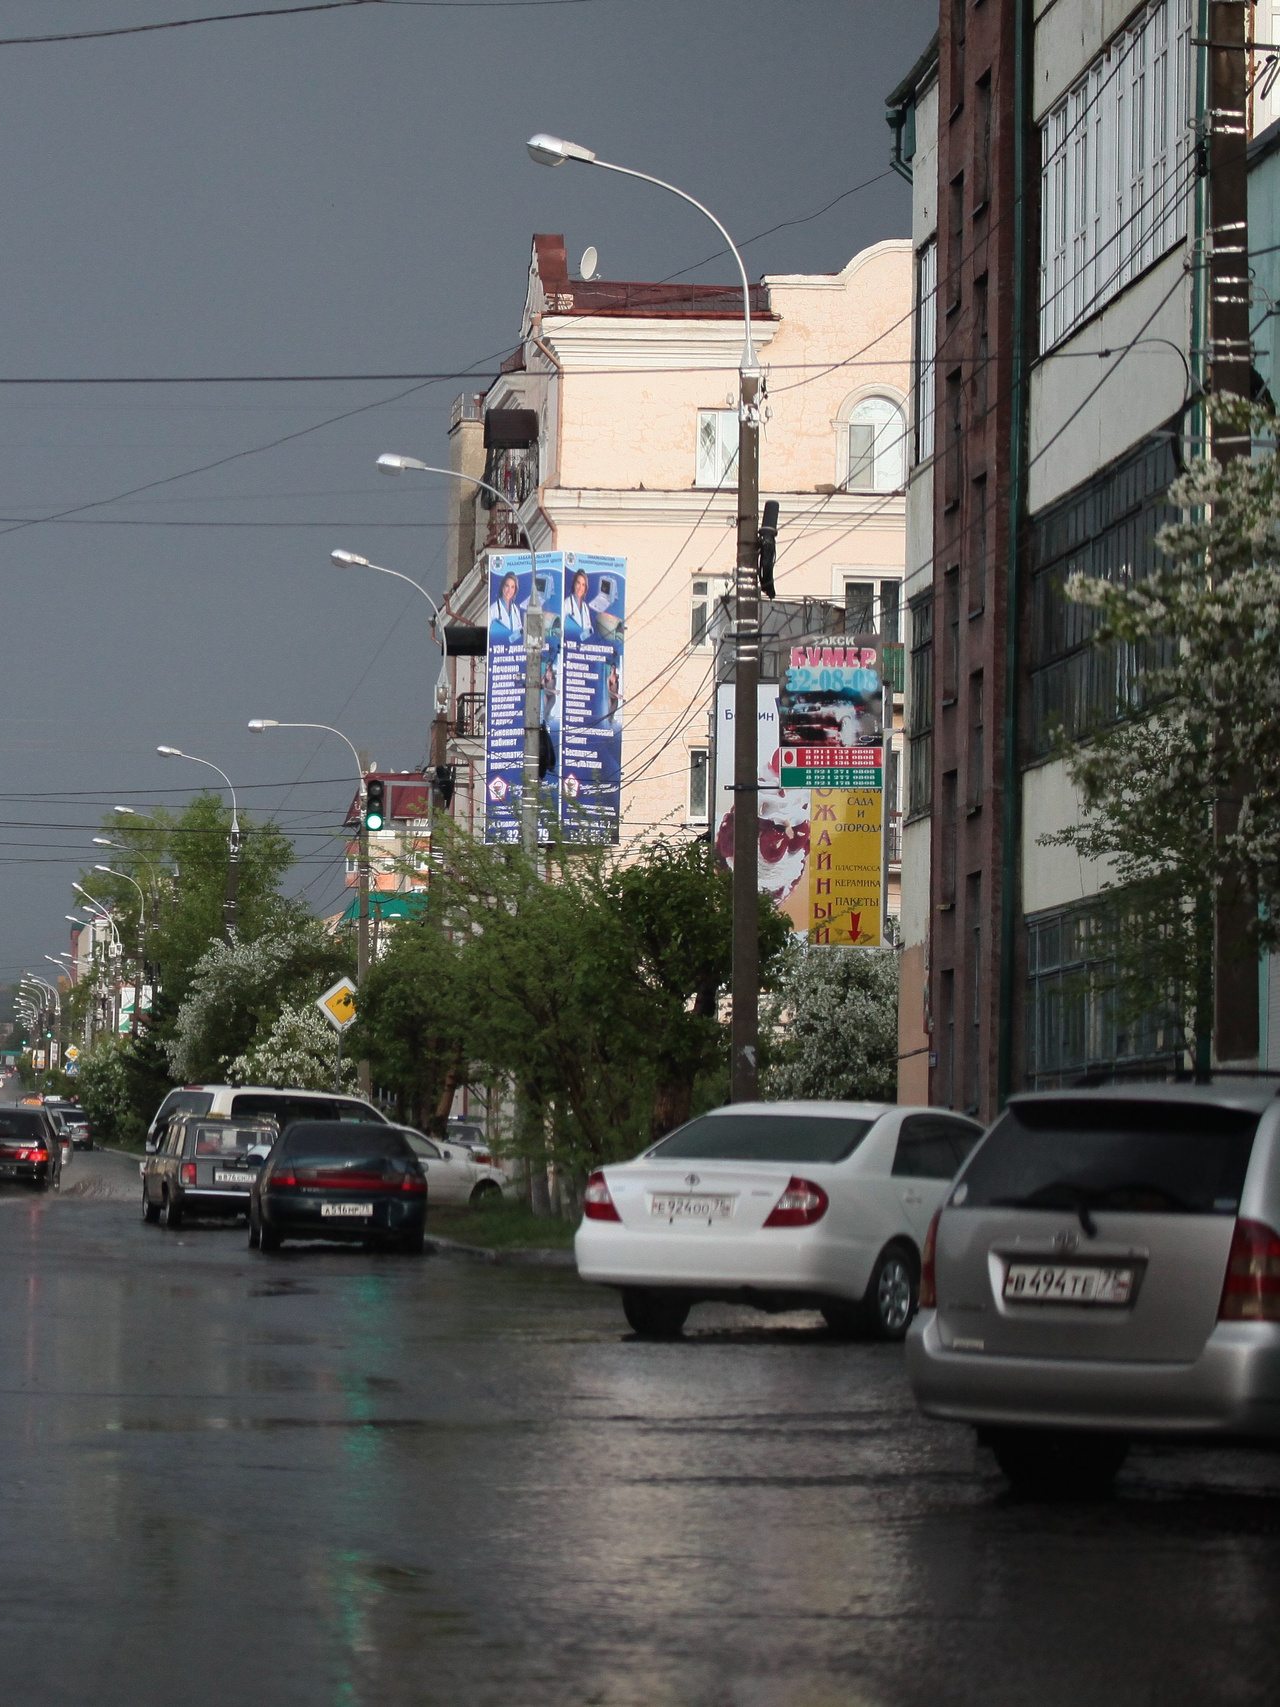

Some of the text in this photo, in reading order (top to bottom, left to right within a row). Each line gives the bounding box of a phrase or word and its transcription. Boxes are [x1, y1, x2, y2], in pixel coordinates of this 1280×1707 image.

[812, 636, 855, 645] ТАКСИ
[790, 646, 876, 669] БУМЕР
[785, 668, 878, 692] 32-08-08
[725, 709, 774, 721] Бин
[847, 797, 874, 806] САДА
[857, 810, 864, 818] И
[835, 823, 882, 832] ОГОРОДА
[835, 879, 881, 887] КЕРАМИКА
[836, 897, 879, 906] ПАКЕТЫ
